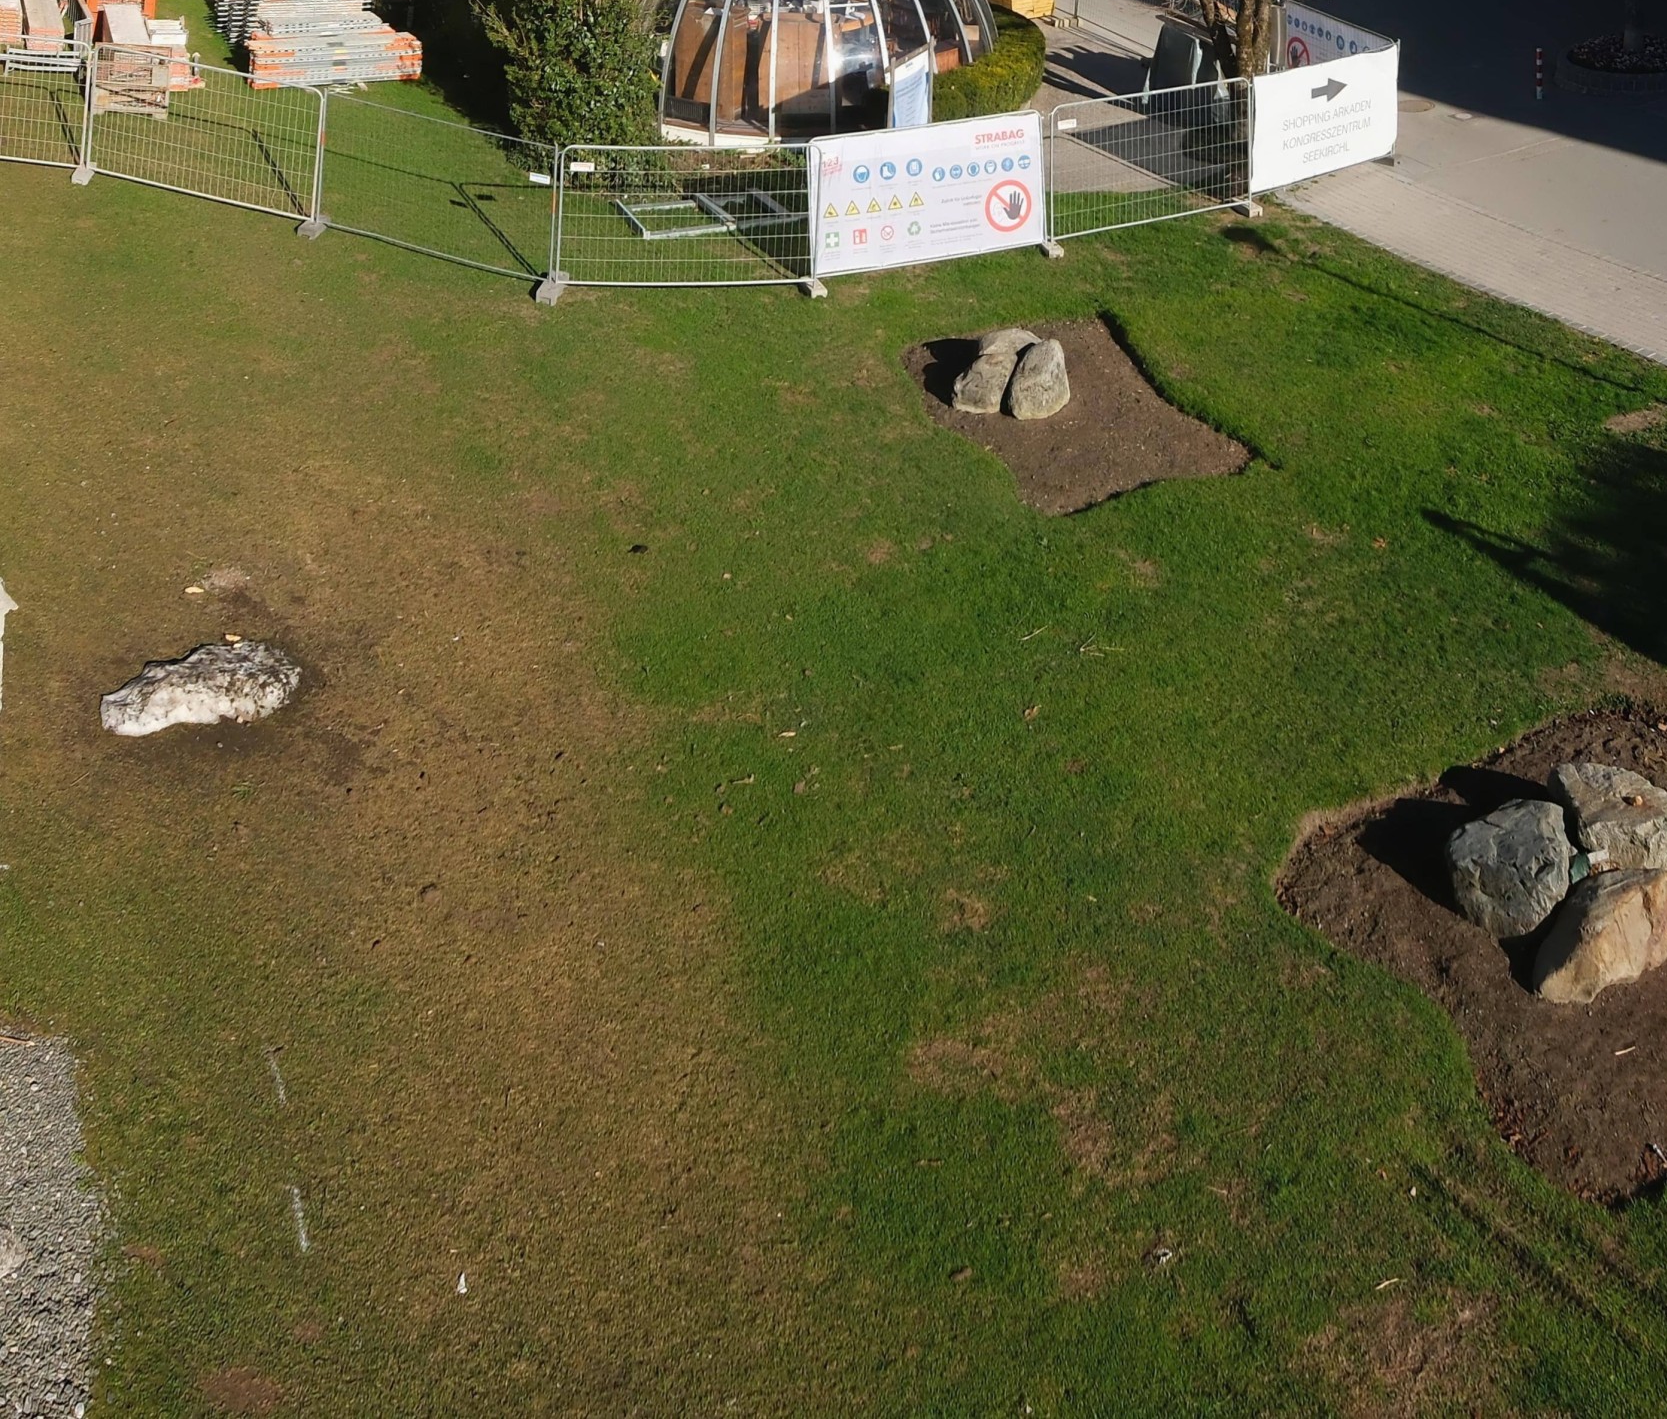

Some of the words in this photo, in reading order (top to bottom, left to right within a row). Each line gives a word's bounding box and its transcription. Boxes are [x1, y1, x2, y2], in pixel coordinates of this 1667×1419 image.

[1282, 110, 1331, 131] SHOPPING
[1332, 99, 1372, 120] ARKADEN
[975, 129, 1025, 144] STRABAG
[1282, 117, 1372, 150] KONGRESSZENTRUM
[1302, 143, 1350, 164] SEEKIRCHL
